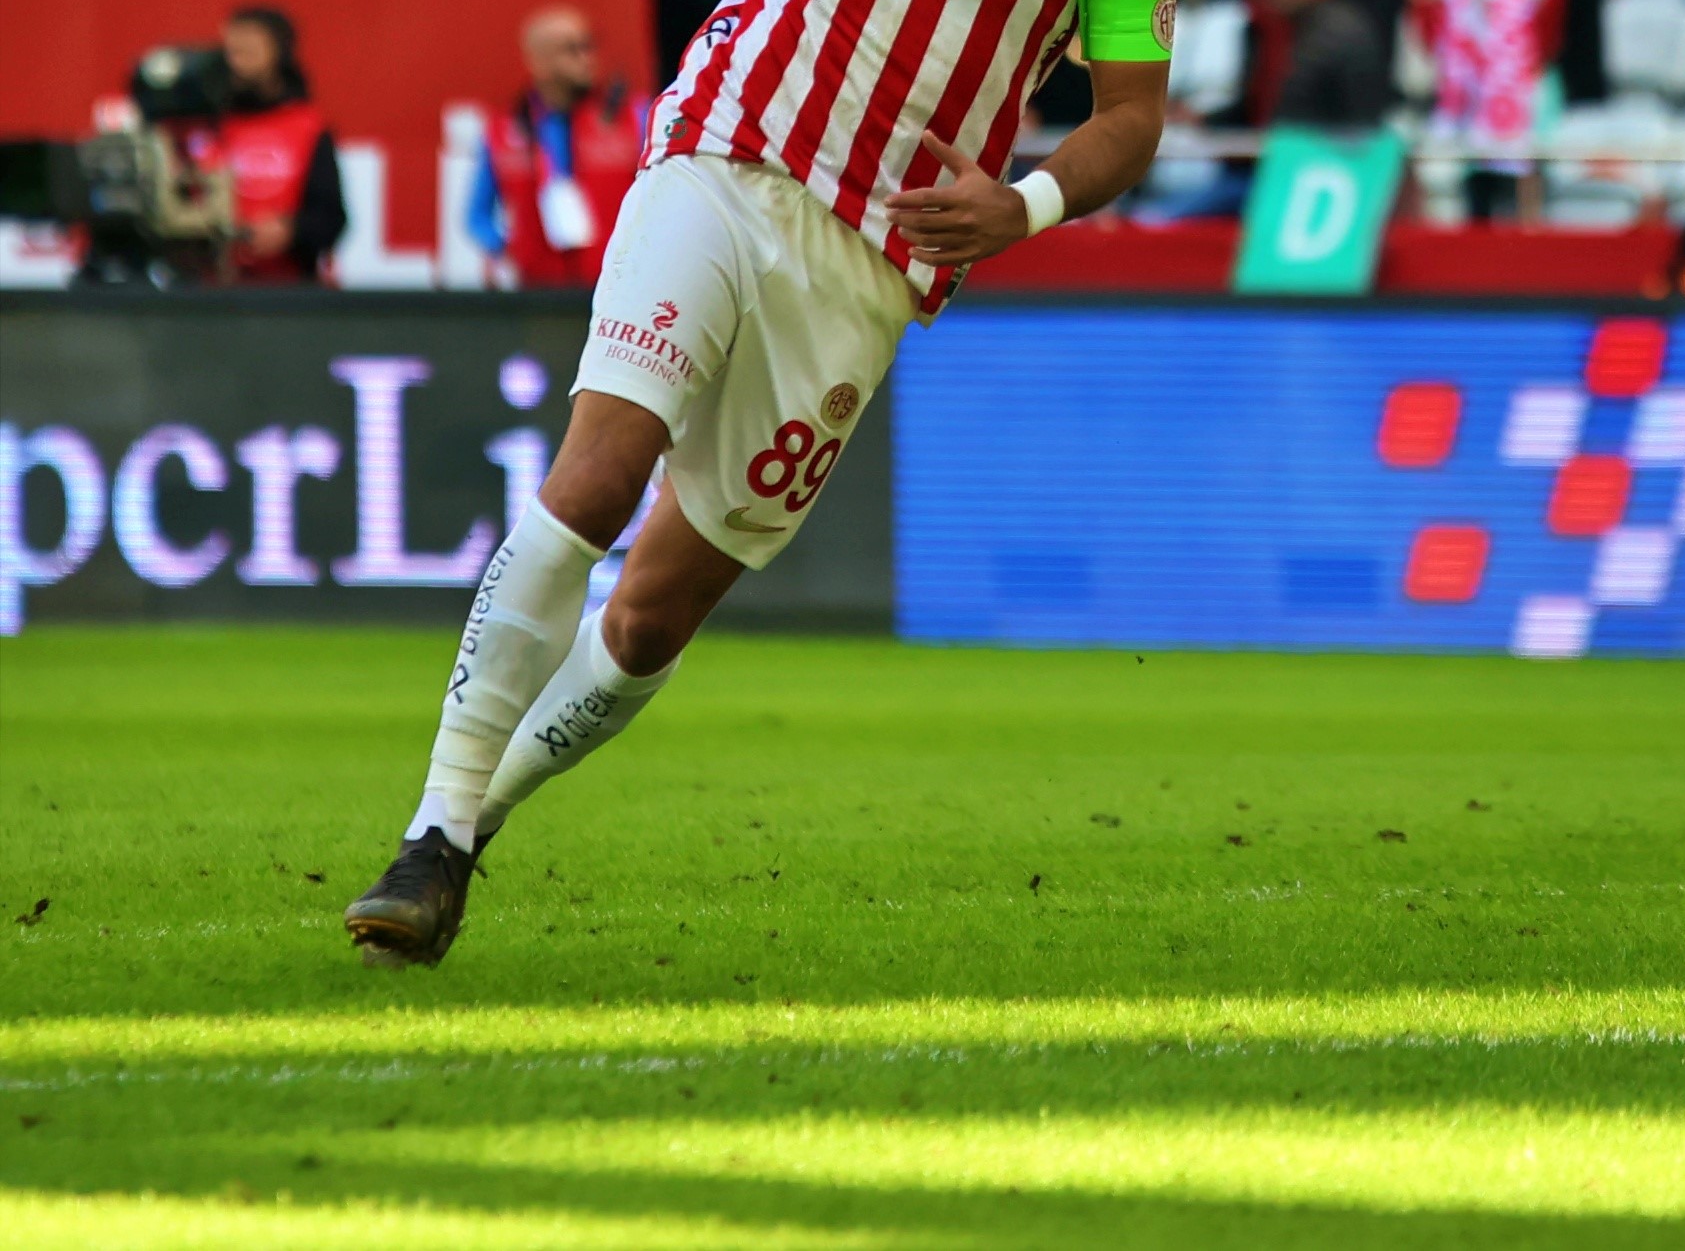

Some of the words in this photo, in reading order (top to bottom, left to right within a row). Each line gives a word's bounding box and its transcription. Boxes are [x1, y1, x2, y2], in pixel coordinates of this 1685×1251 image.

[1278, 159, 1358, 262] D
[746, 419, 842, 513] 89
[558, 685, 618, 739] bitex
